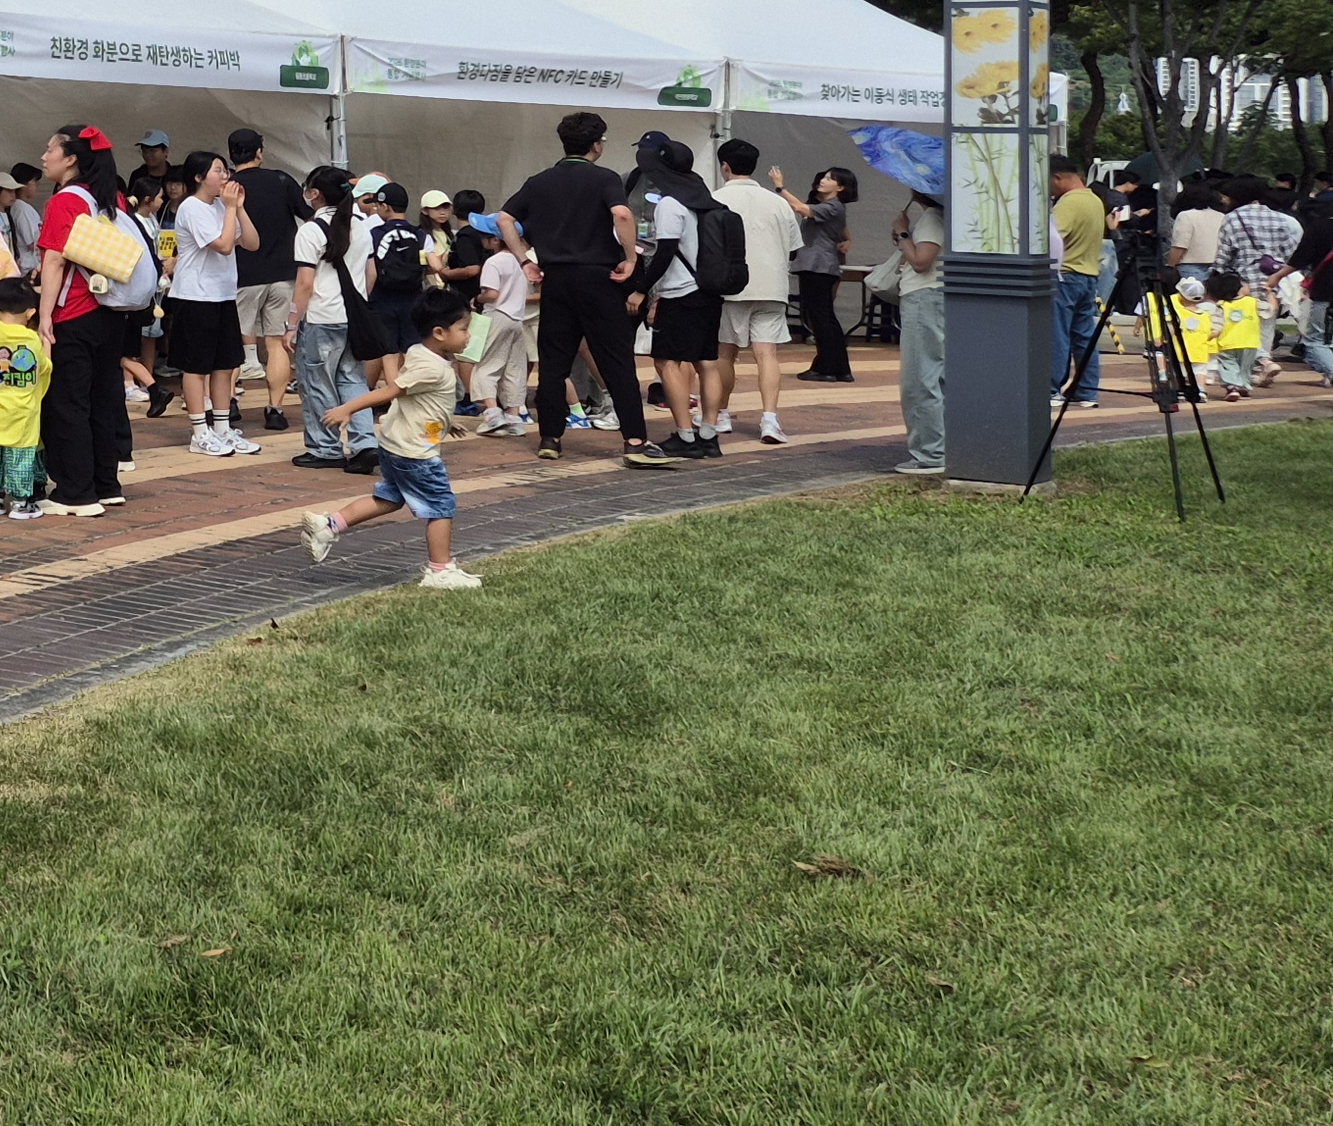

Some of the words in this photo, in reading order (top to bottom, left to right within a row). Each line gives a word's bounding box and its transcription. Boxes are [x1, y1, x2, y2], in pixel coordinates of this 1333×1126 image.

[50, 35, 89, 61] 친환경
[92, 38, 144, 64] 화분으로
[146, 44, 205, 70] 재탄생하는
[207, 48, 241, 72] 커피박
[457, 61, 514, 83] 환경다짐을
[514, 65, 537, 84] 담은
[537, 68, 565, 84] NFC
[564, 70, 588, 87] 카드
[589, 70, 623, 89] 만들기
[820, 83, 862, 103] 찾아가는
[863, 87, 895, 106] 이동식
[897, 89, 918, 106] 생태
